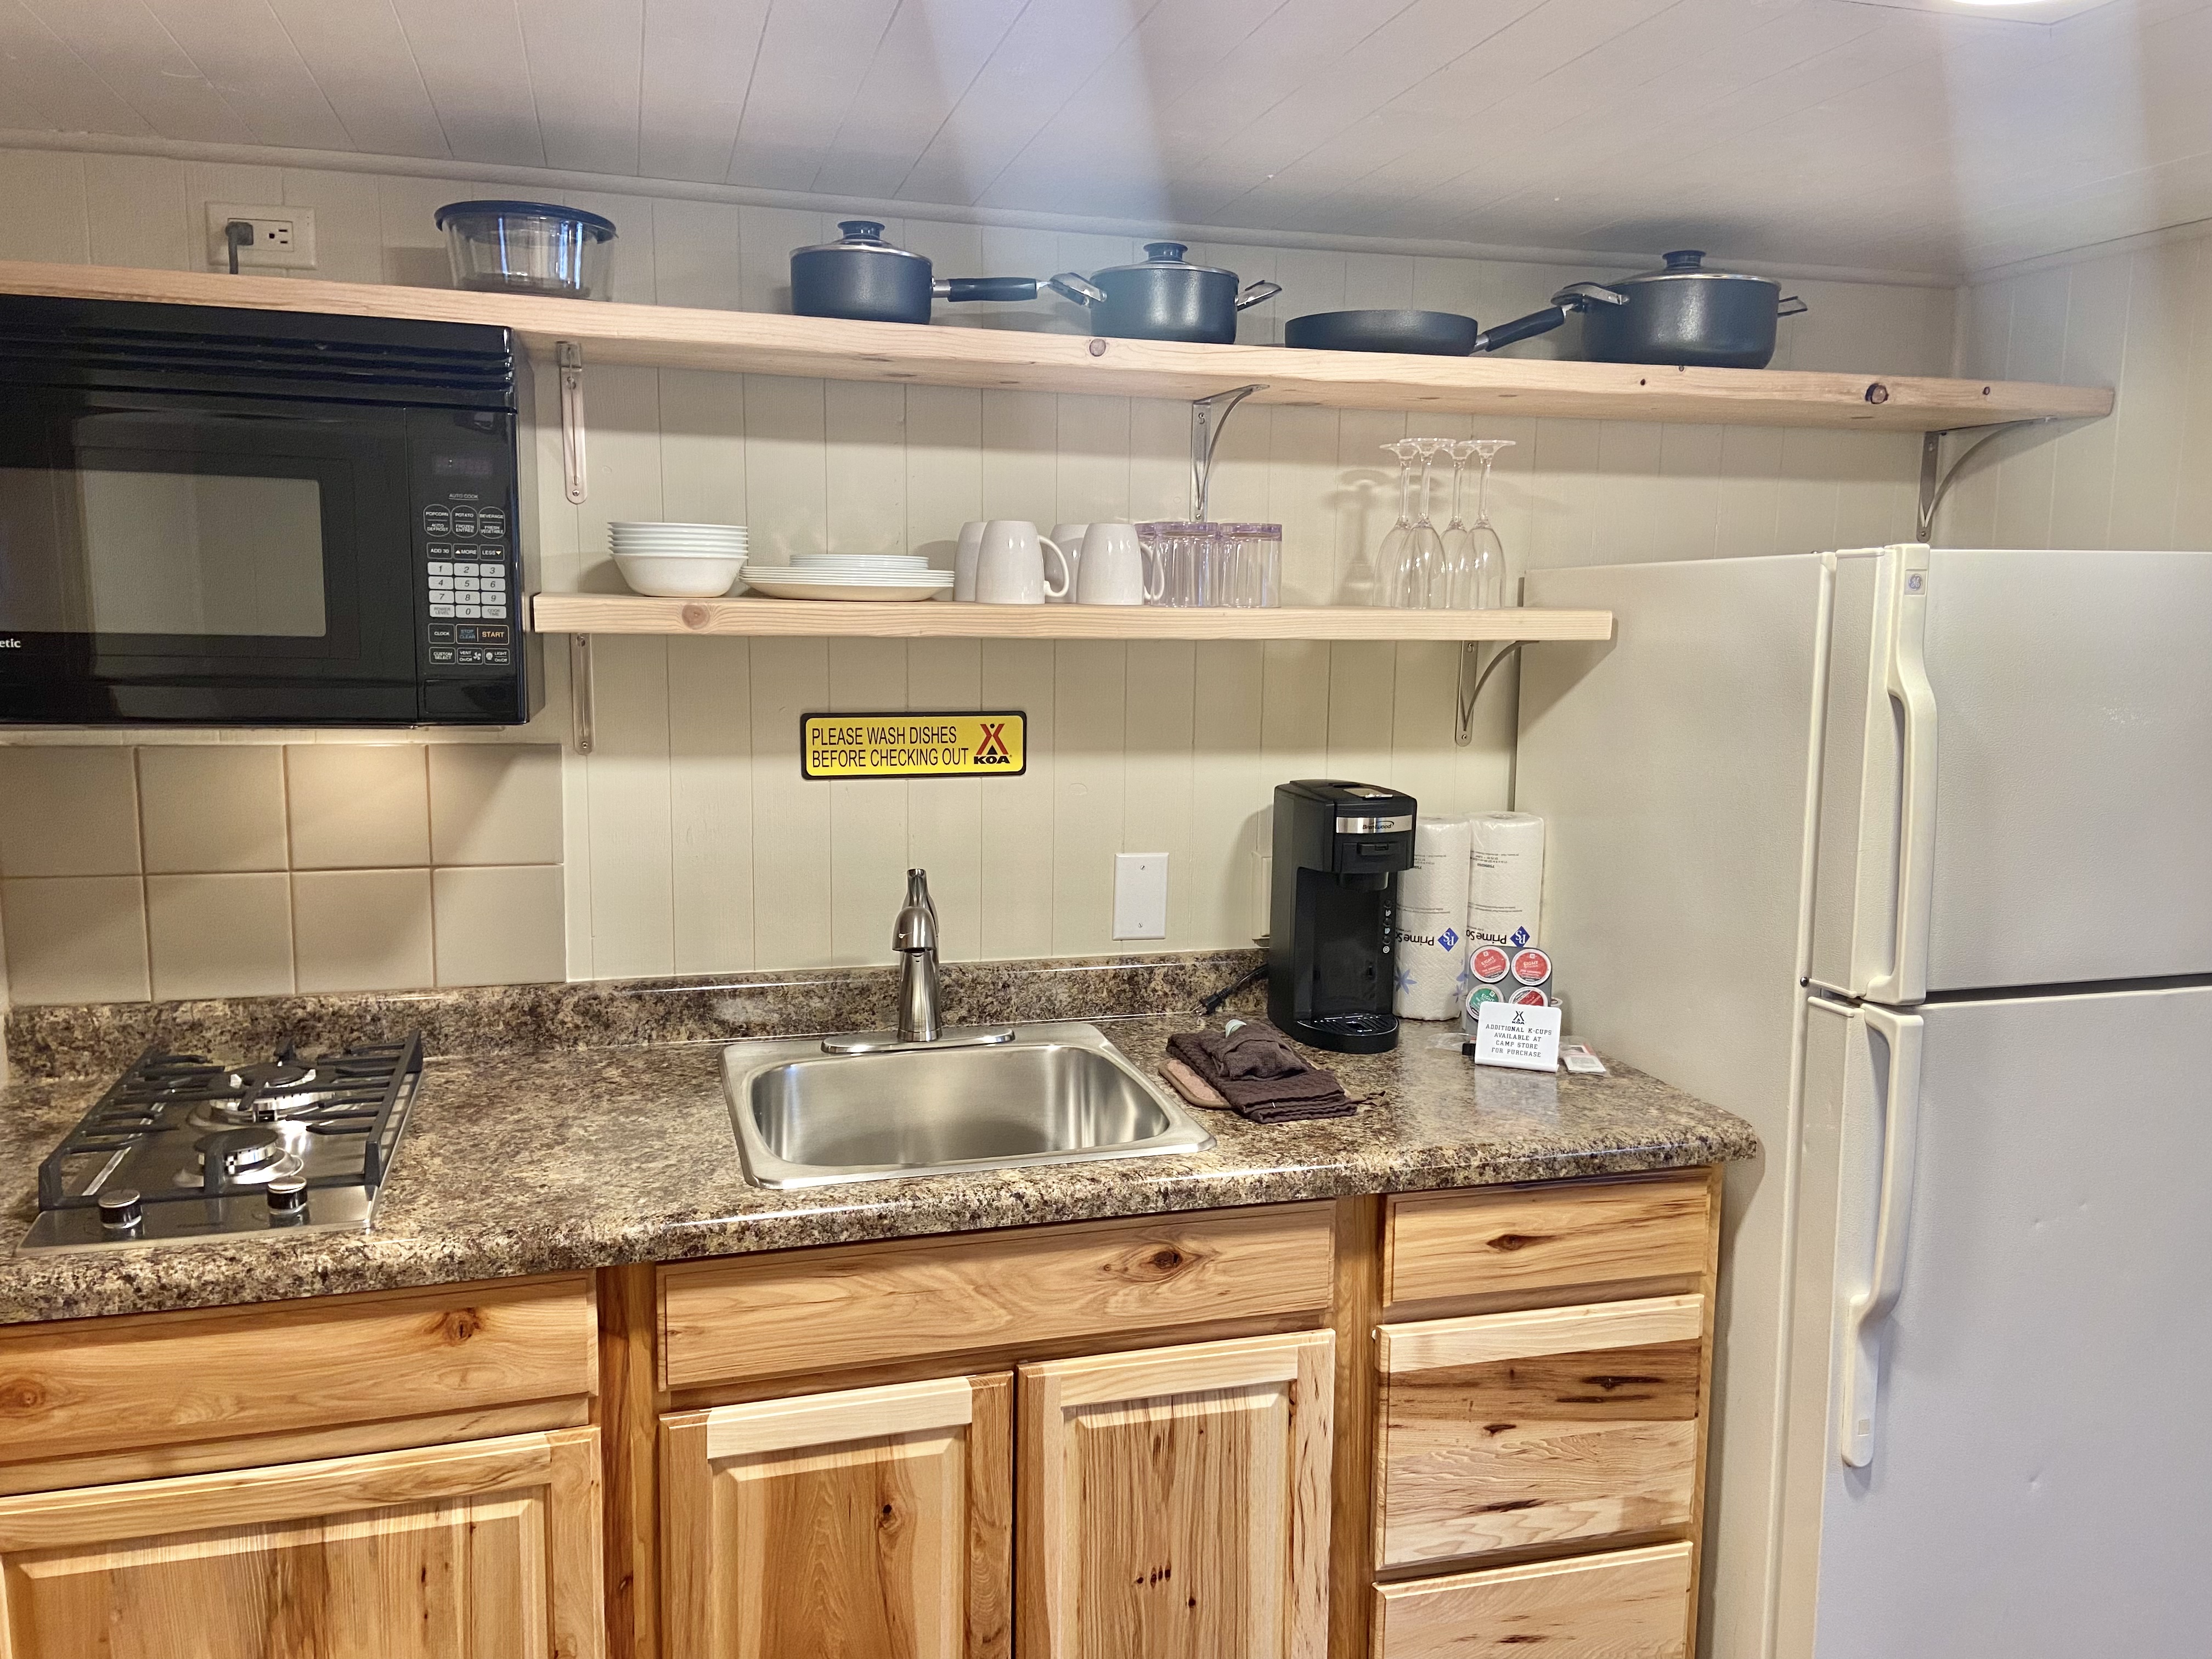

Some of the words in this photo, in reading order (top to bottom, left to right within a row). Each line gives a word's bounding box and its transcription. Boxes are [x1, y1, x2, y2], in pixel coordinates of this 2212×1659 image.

[812, 727, 863, 746] PLEASE
[867, 726, 905, 745] WASH
[910, 726, 957, 744] DISHES
[812, 749, 866, 768] BEFORE
[871, 748, 938, 767] CHECKING
[942, 748, 969, 765] OUT
[974, 756, 1010, 764] KOA
[1404, 934, 1435, 946] Prime
[1443, 932, 1454, 946] PS
[1476, 933, 1506, 944] Prime
[1516, 930, 1526, 944] PS
[1486, 1024, 1524, 1032] ADDITIONAL
[1494, 1032, 1530, 1041] AVAILABLE
[1507, 1049, 1542, 1057] PURCHASE
